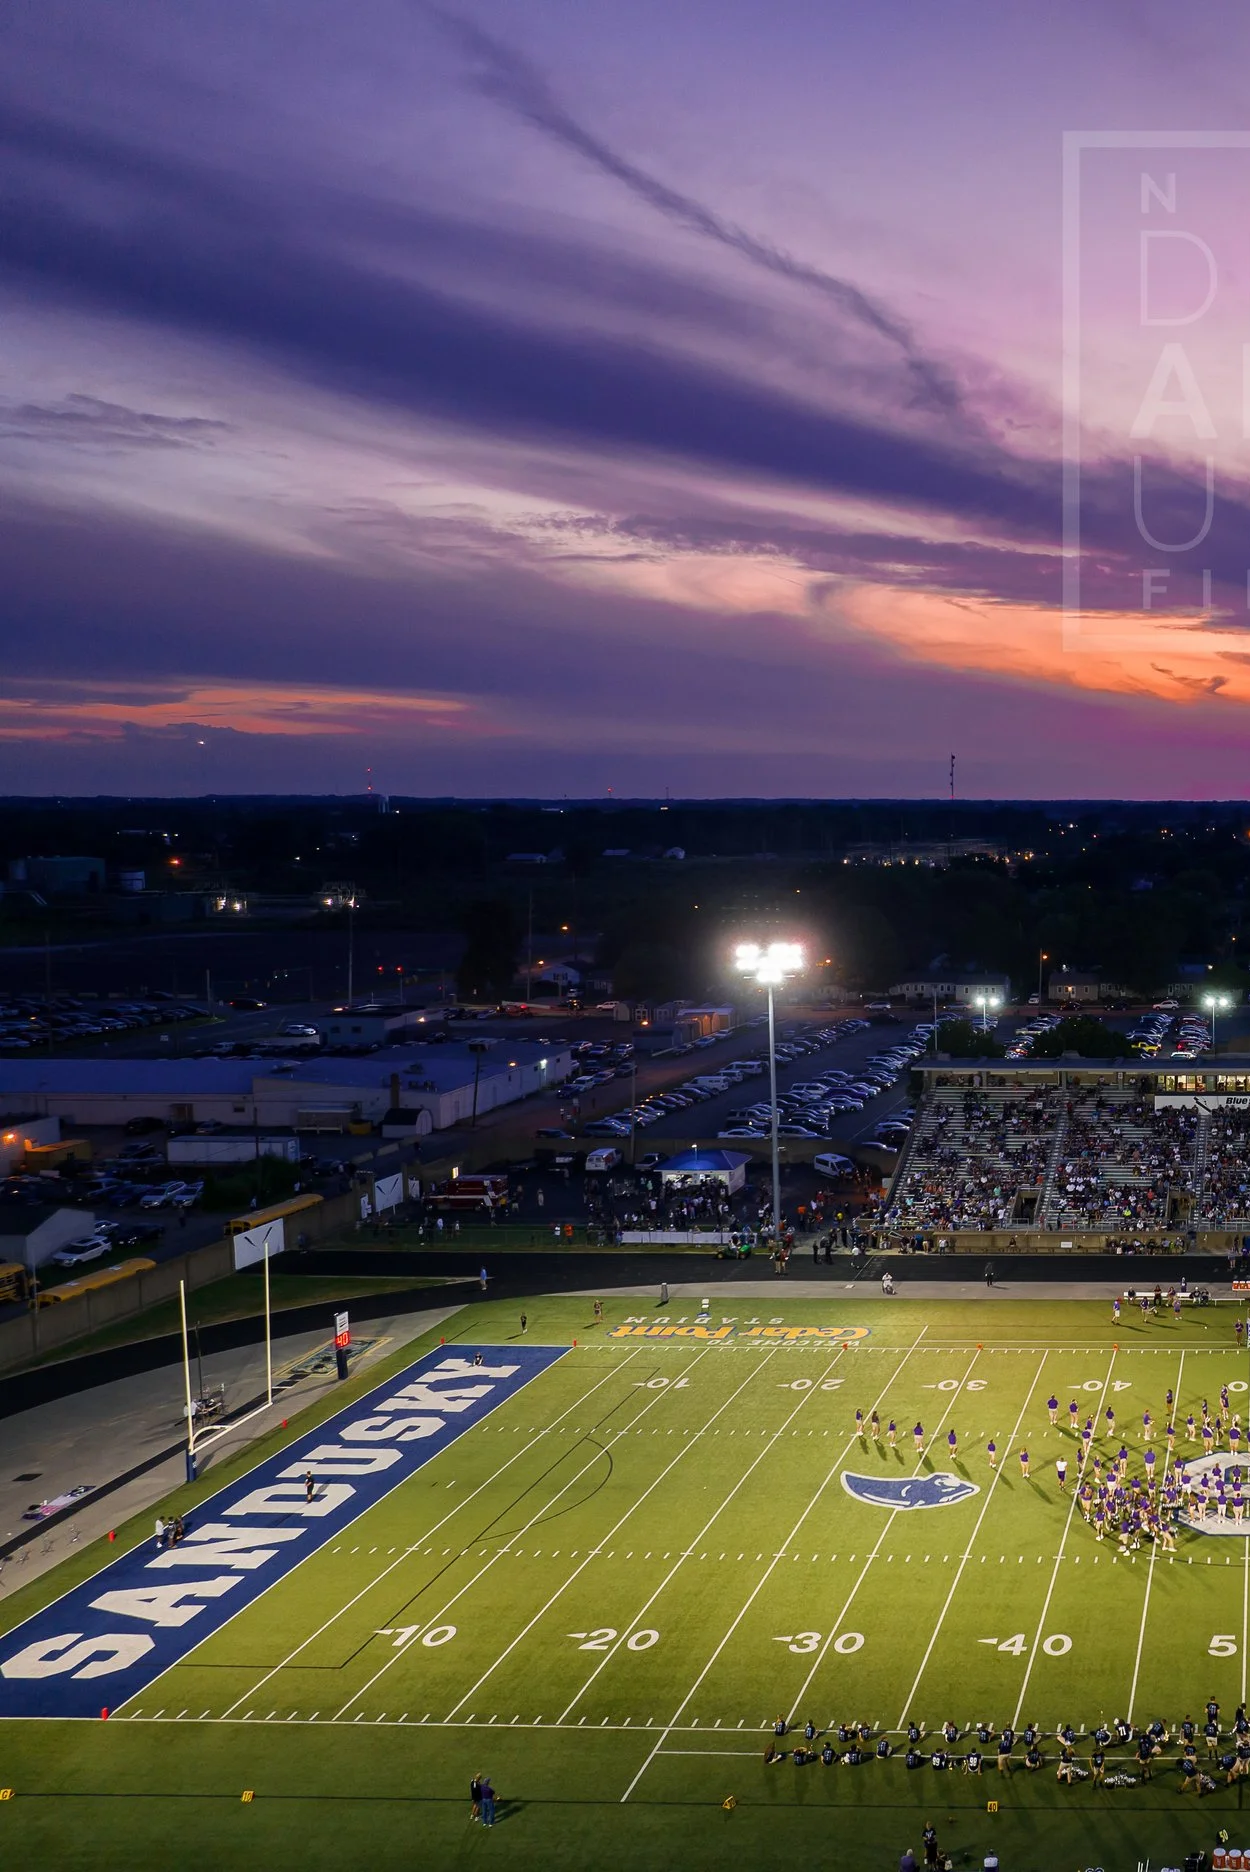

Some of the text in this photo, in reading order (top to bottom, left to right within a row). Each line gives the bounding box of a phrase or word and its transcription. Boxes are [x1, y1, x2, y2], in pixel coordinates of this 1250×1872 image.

[1226, 1097, 1248, 1105] Blue
[623, 1317, 785, 1325] STADIUM
[336, 1332, 349, 1348] 40
[608, 1325, 871, 1341] Cedar Point
[748, 1339, 861, 1347] WELCOME
[647, 1377, 692, 1390] 10
[789, 1379, 847, 1391] 20
[937, 1379, 988, 1392] 30
[1081, 1380, 1133, 1392] 40
[0, 1357, 522, 1681] SANDUSKY
[388, 1624, 457, 1647] 10
[578, 1628, 660, 1651] 20
[788, 1632, 865, 1654] 30
[998, 1634, 1073, 1656] 40
